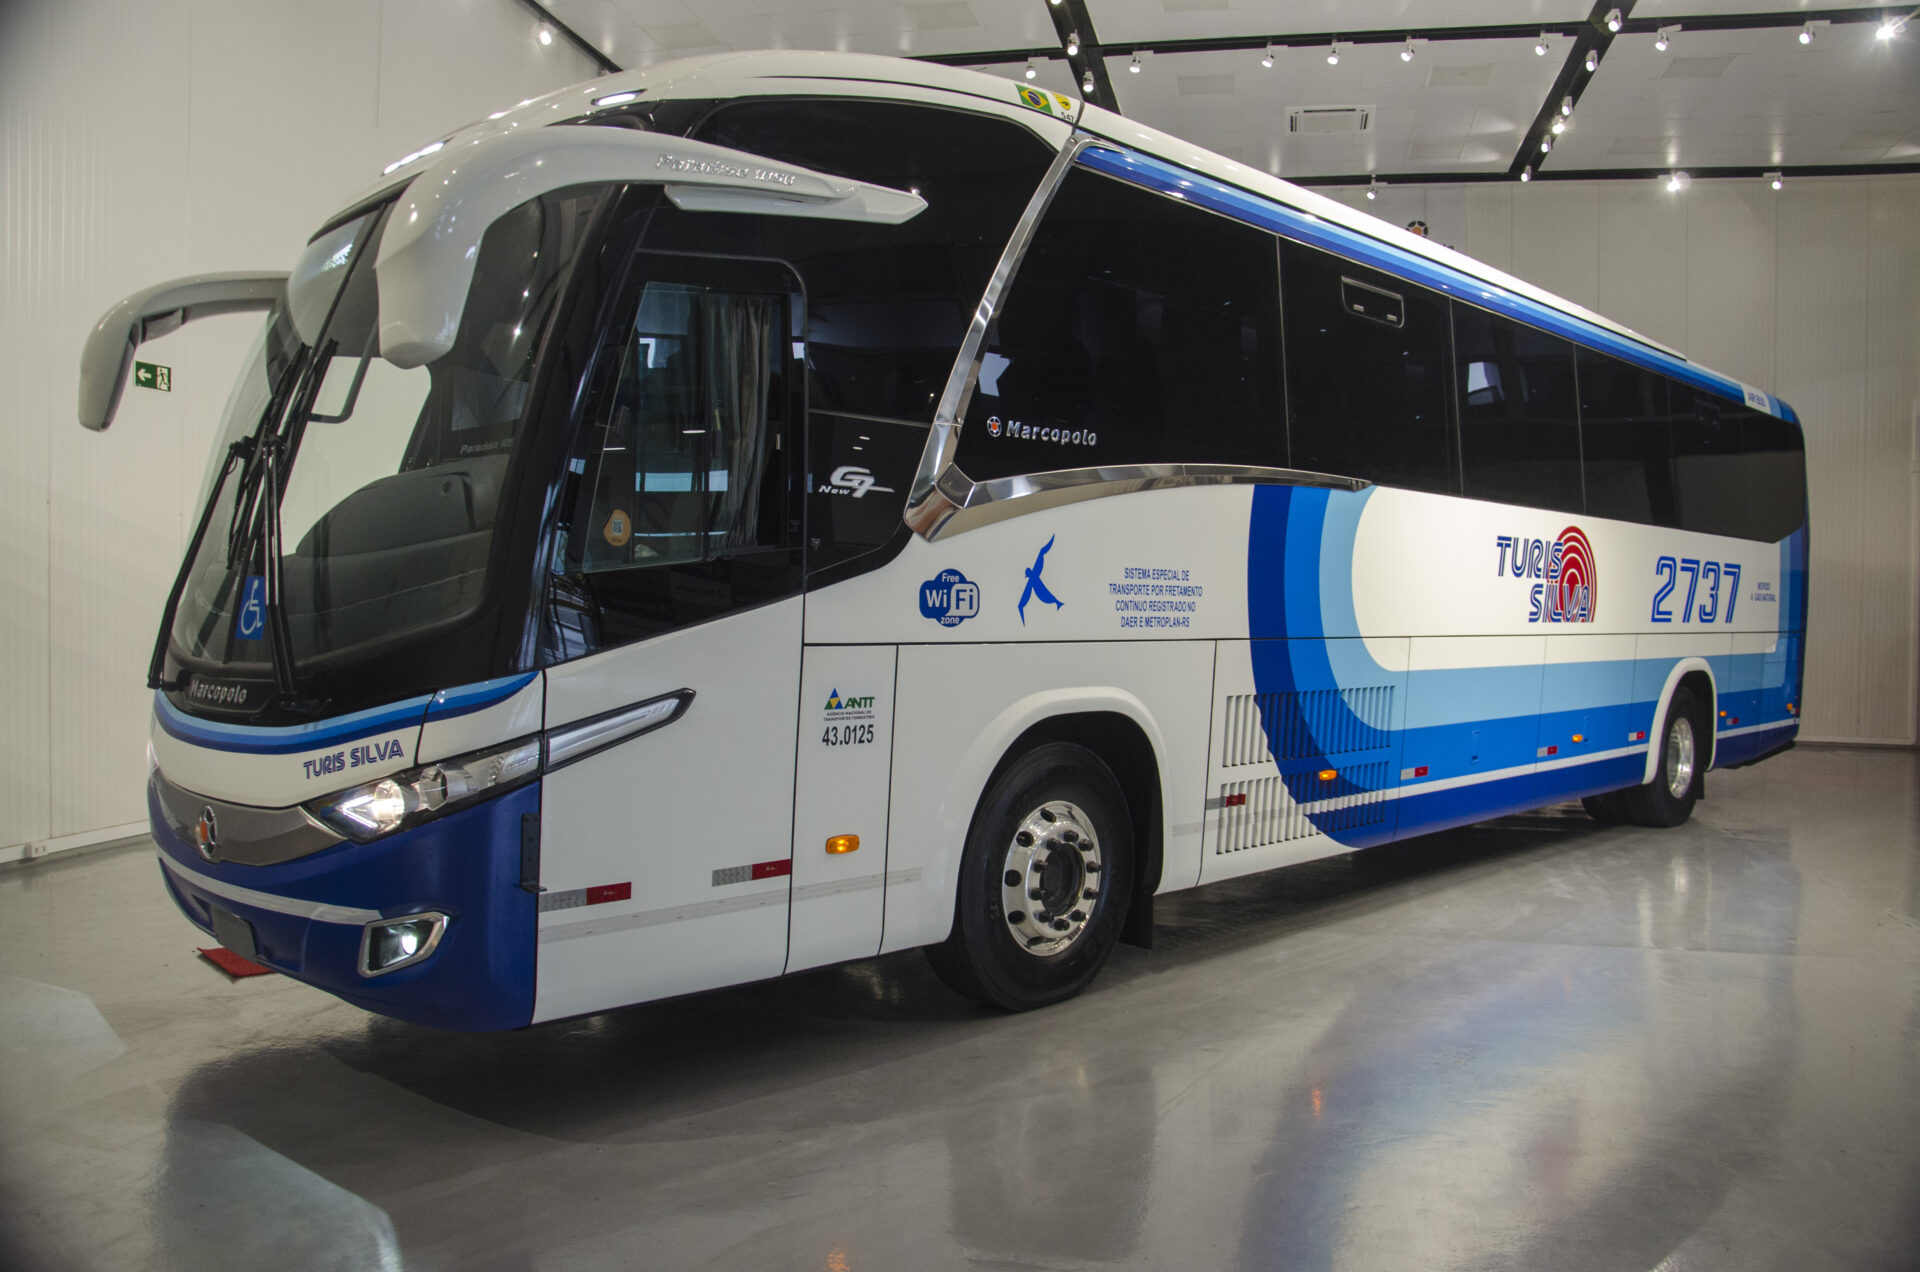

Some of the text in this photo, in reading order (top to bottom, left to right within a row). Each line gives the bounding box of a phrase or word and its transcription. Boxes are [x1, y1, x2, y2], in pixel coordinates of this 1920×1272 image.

[1005, 420, 1097, 446] Marcopolo
[818, 484, 850, 495] New
[1496, 535, 1564, 580] TURIS
[941, 572, 960, 583] Free
[1124, 567, 1190, 582] SISTEMA ESPECIAL DE
[1109, 583, 1203, 597] TRANSPORTE POR FRETAMENTO
[1651, 555, 1742, 624] 2737
[1148, 600, 1186, 612] REGISTRADO
[1187, 601, 1196, 613] NO
[1528, 583, 1590, 623] SILVA
[940, 616, 960, 624] zone
[1120, 616, 1190, 628] DAER E METROPLAN-RS
[189, 679, 248, 704] Marcopolo
[843, 696, 875, 710] ANTT
[822, 723, 874, 747] 43.0125
[303, 739, 404, 780] TURIS SILVA
